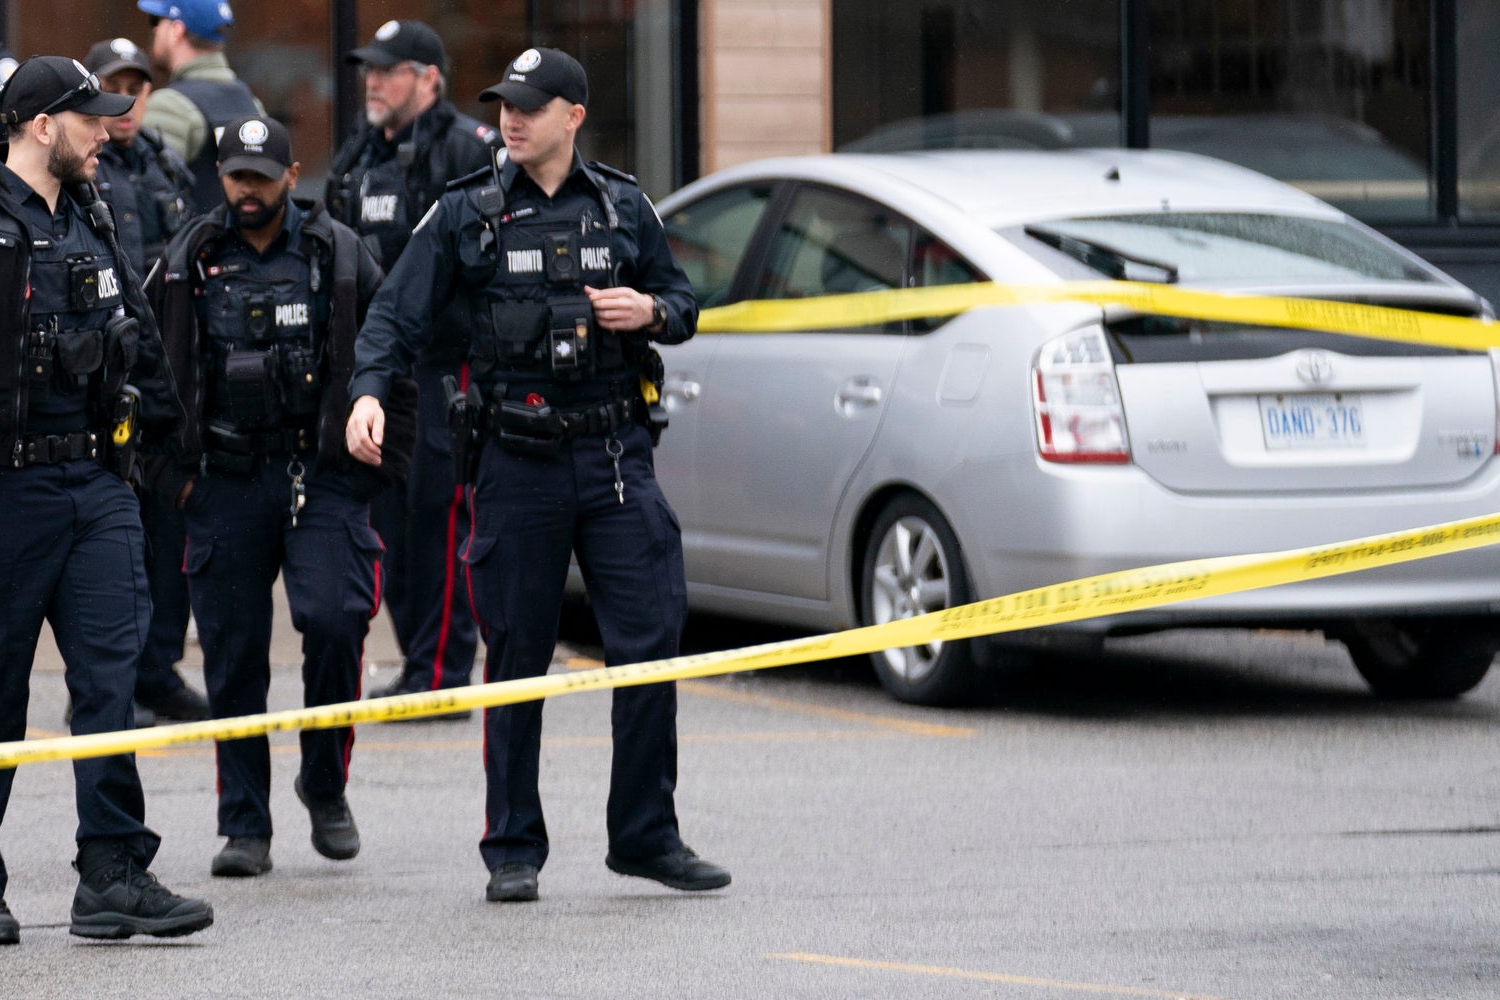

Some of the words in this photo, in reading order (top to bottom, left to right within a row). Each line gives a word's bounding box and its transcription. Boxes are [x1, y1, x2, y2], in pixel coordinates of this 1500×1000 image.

[361, 194, 398, 222] POLICE
[507, 249, 543, 273] TORONTO
[98, 267, 120, 299] OLICE
[275, 303, 309, 327] POLICE
[1326, 406, 1362, 437] 376
